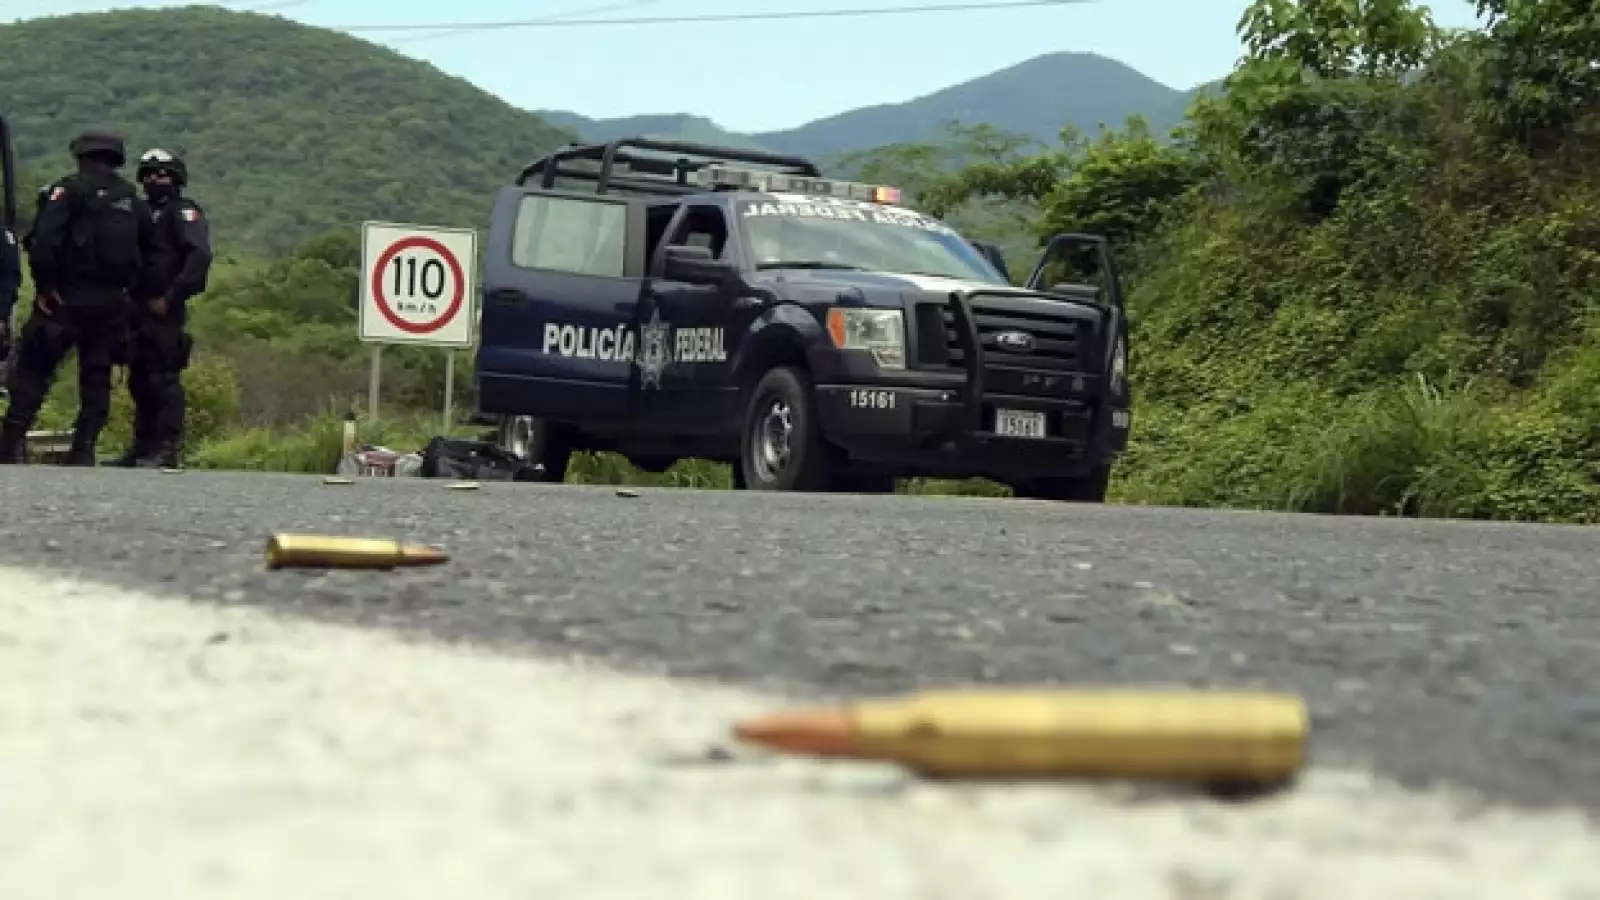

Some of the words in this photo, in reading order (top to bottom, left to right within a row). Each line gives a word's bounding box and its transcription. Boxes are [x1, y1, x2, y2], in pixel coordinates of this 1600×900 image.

[393, 256, 446, 299] 110
[543, 322, 635, 362] POLICÍA
[674, 327, 727, 363] FEDERAL
[850, 390, 896, 409] 15161
